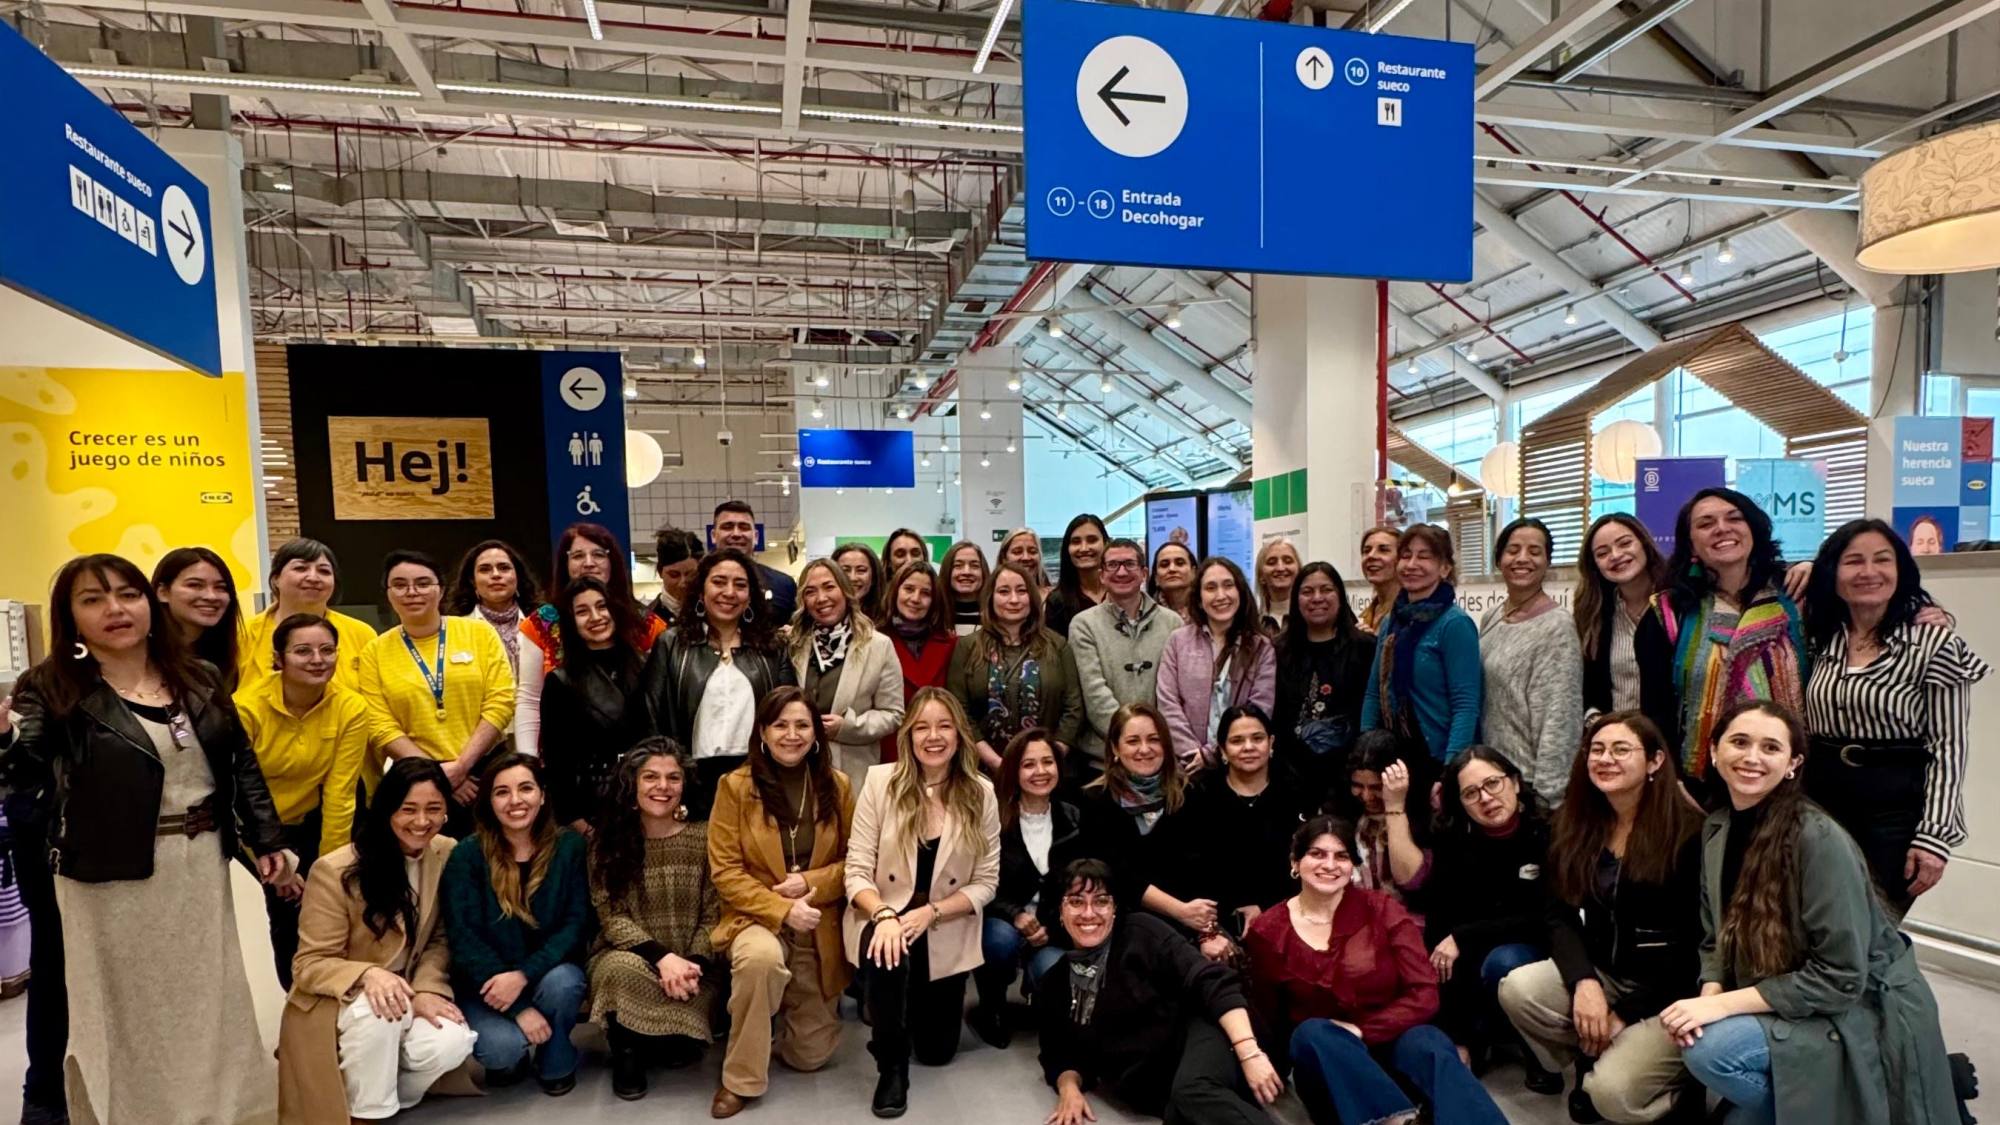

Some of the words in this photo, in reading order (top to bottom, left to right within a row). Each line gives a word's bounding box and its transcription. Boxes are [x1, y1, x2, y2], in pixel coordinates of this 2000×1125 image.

[1350, 66, 1364, 78] 10
[1377, 61, 1447, 79] Restaurante
[1377, 80, 1410, 92] sueco
[65, 122, 126, 180] Restaurante
[126, 170, 153, 198] sueco
[1054, 196, 1067, 207] 11
[1094, 199, 1108, 210] 18
[1122, 189, 1182, 207] Entrada
[1122, 209, 1205, 230] Decohogar
[69, 431, 138, 446] Crecer
[145, 433, 166, 446] es
[174, 434, 200, 446] un
[1903, 440, 1949, 452] Nuestra
[69, 451, 130, 470] juego
[137, 451, 162, 466] de
[169, 452, 226, 467] niños
[355, 440, 468, 495] Hej!
[1902, 457, 1952, 469] herencia
[1901, 476, 1935, 486] sueca
